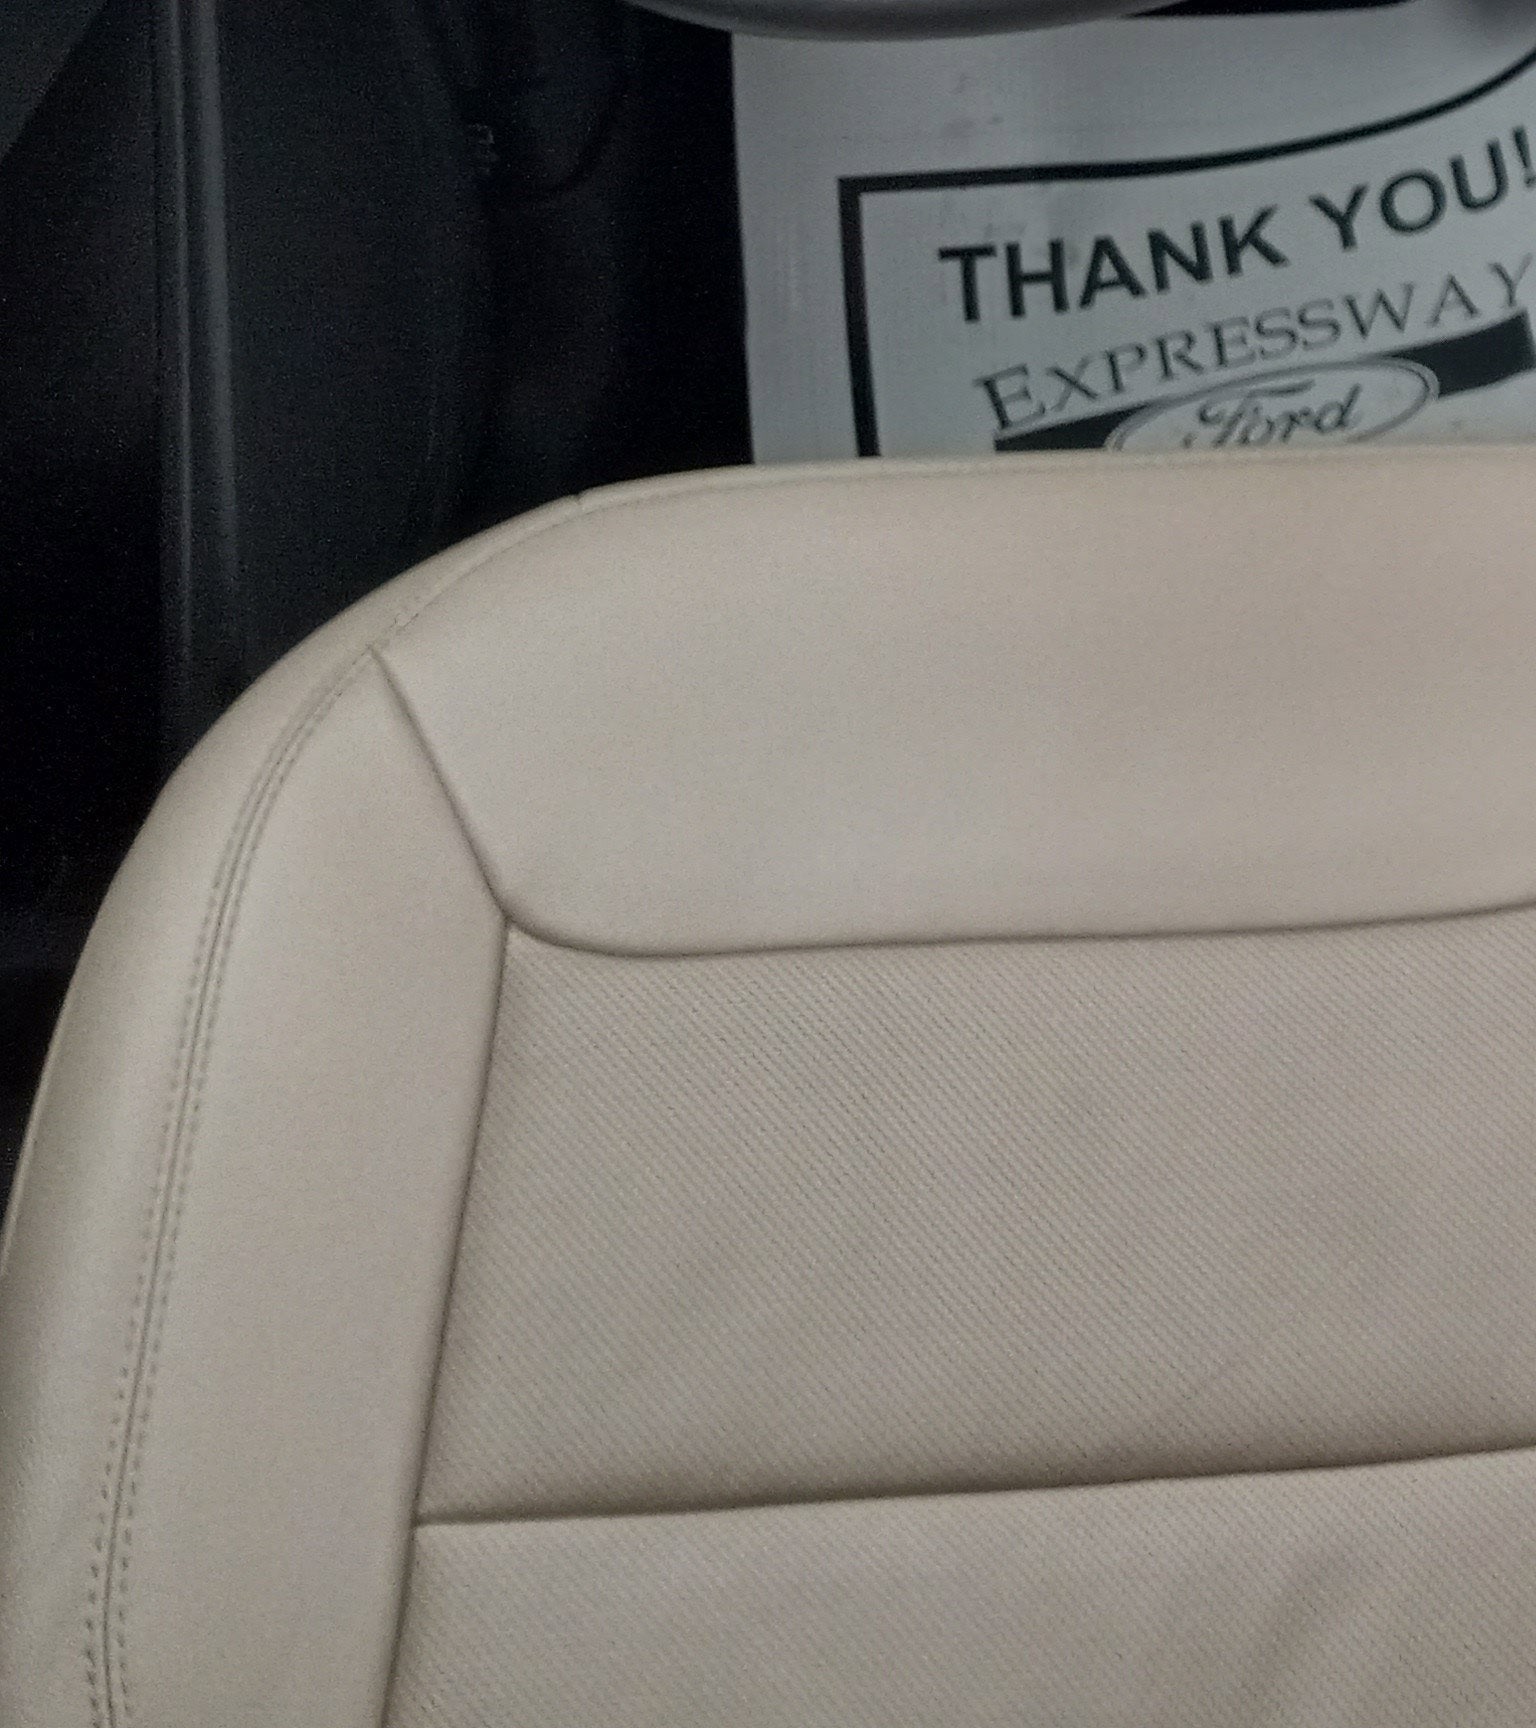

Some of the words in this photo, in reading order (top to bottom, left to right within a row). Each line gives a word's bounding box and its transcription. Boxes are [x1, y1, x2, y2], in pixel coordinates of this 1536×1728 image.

[938, 206, 1287, 325] THANK
[973, 255, 1534, 431] EXPRESSWAY
[1192, 374, 1368, 451] Ford
